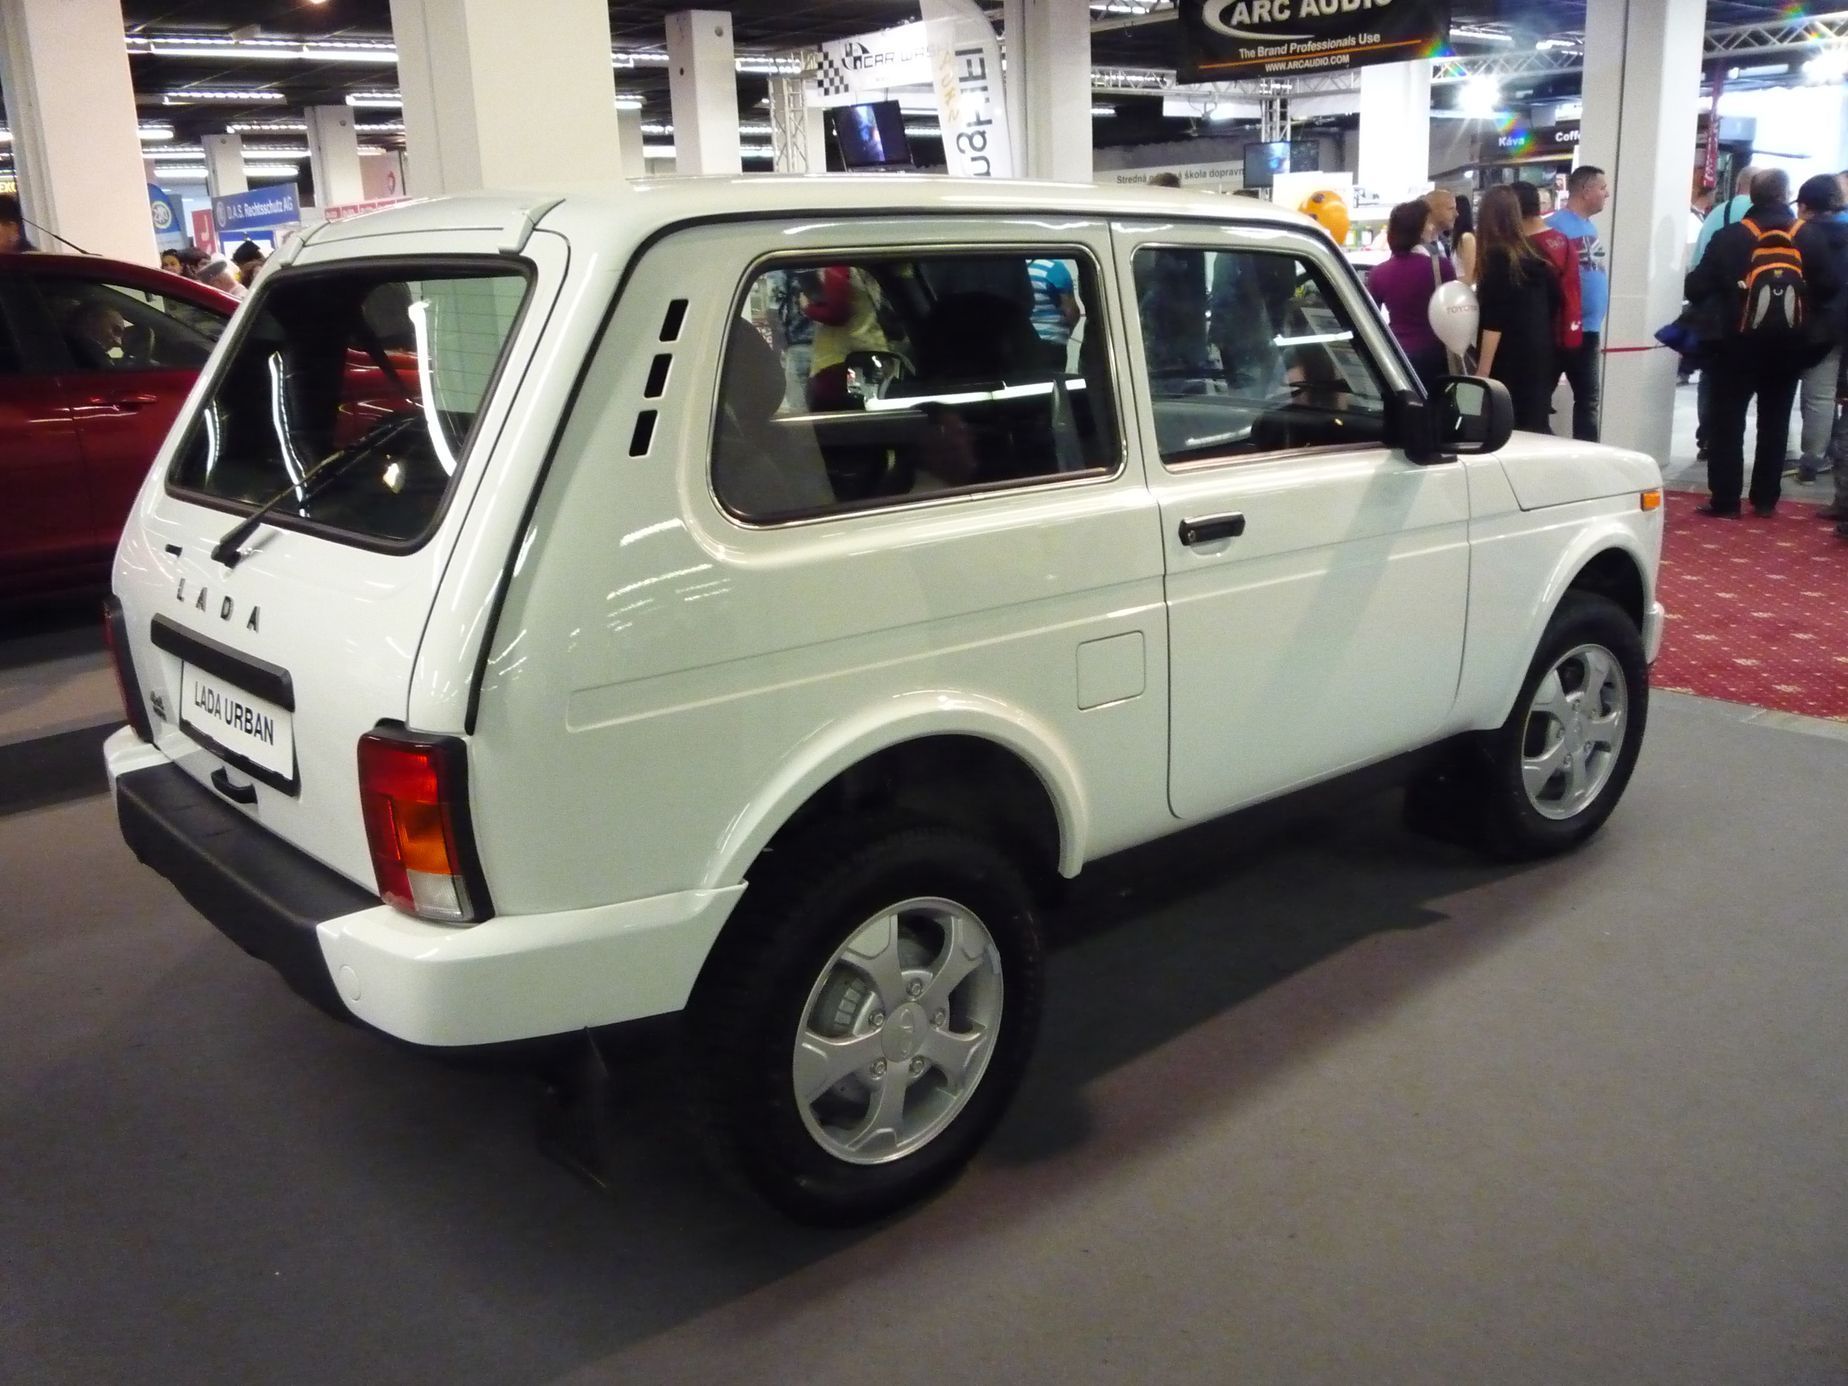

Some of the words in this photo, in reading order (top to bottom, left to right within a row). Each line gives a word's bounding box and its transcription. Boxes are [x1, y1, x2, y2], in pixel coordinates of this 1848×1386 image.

[1230, 0, 1291, 26] ARC
[1239, 48, 1256, 59] The
[1257, 43, 1287, 57] Brand
[1290, 35, 1356, 53] Professionals
[1358, 33, 1381, 44] Use
[863, 52, 896, 69] CAR
[1265, 55, 1350, 72] WWW.ARCAUDIO.COM
[1498, 137, 1525, 146] Káva
[1184, 170, 1207, 179] škola
[177, 578, 261, 633] LADA
[194, 681, 223, 720] LADA
[224, 697, 274, 746] URBAN
